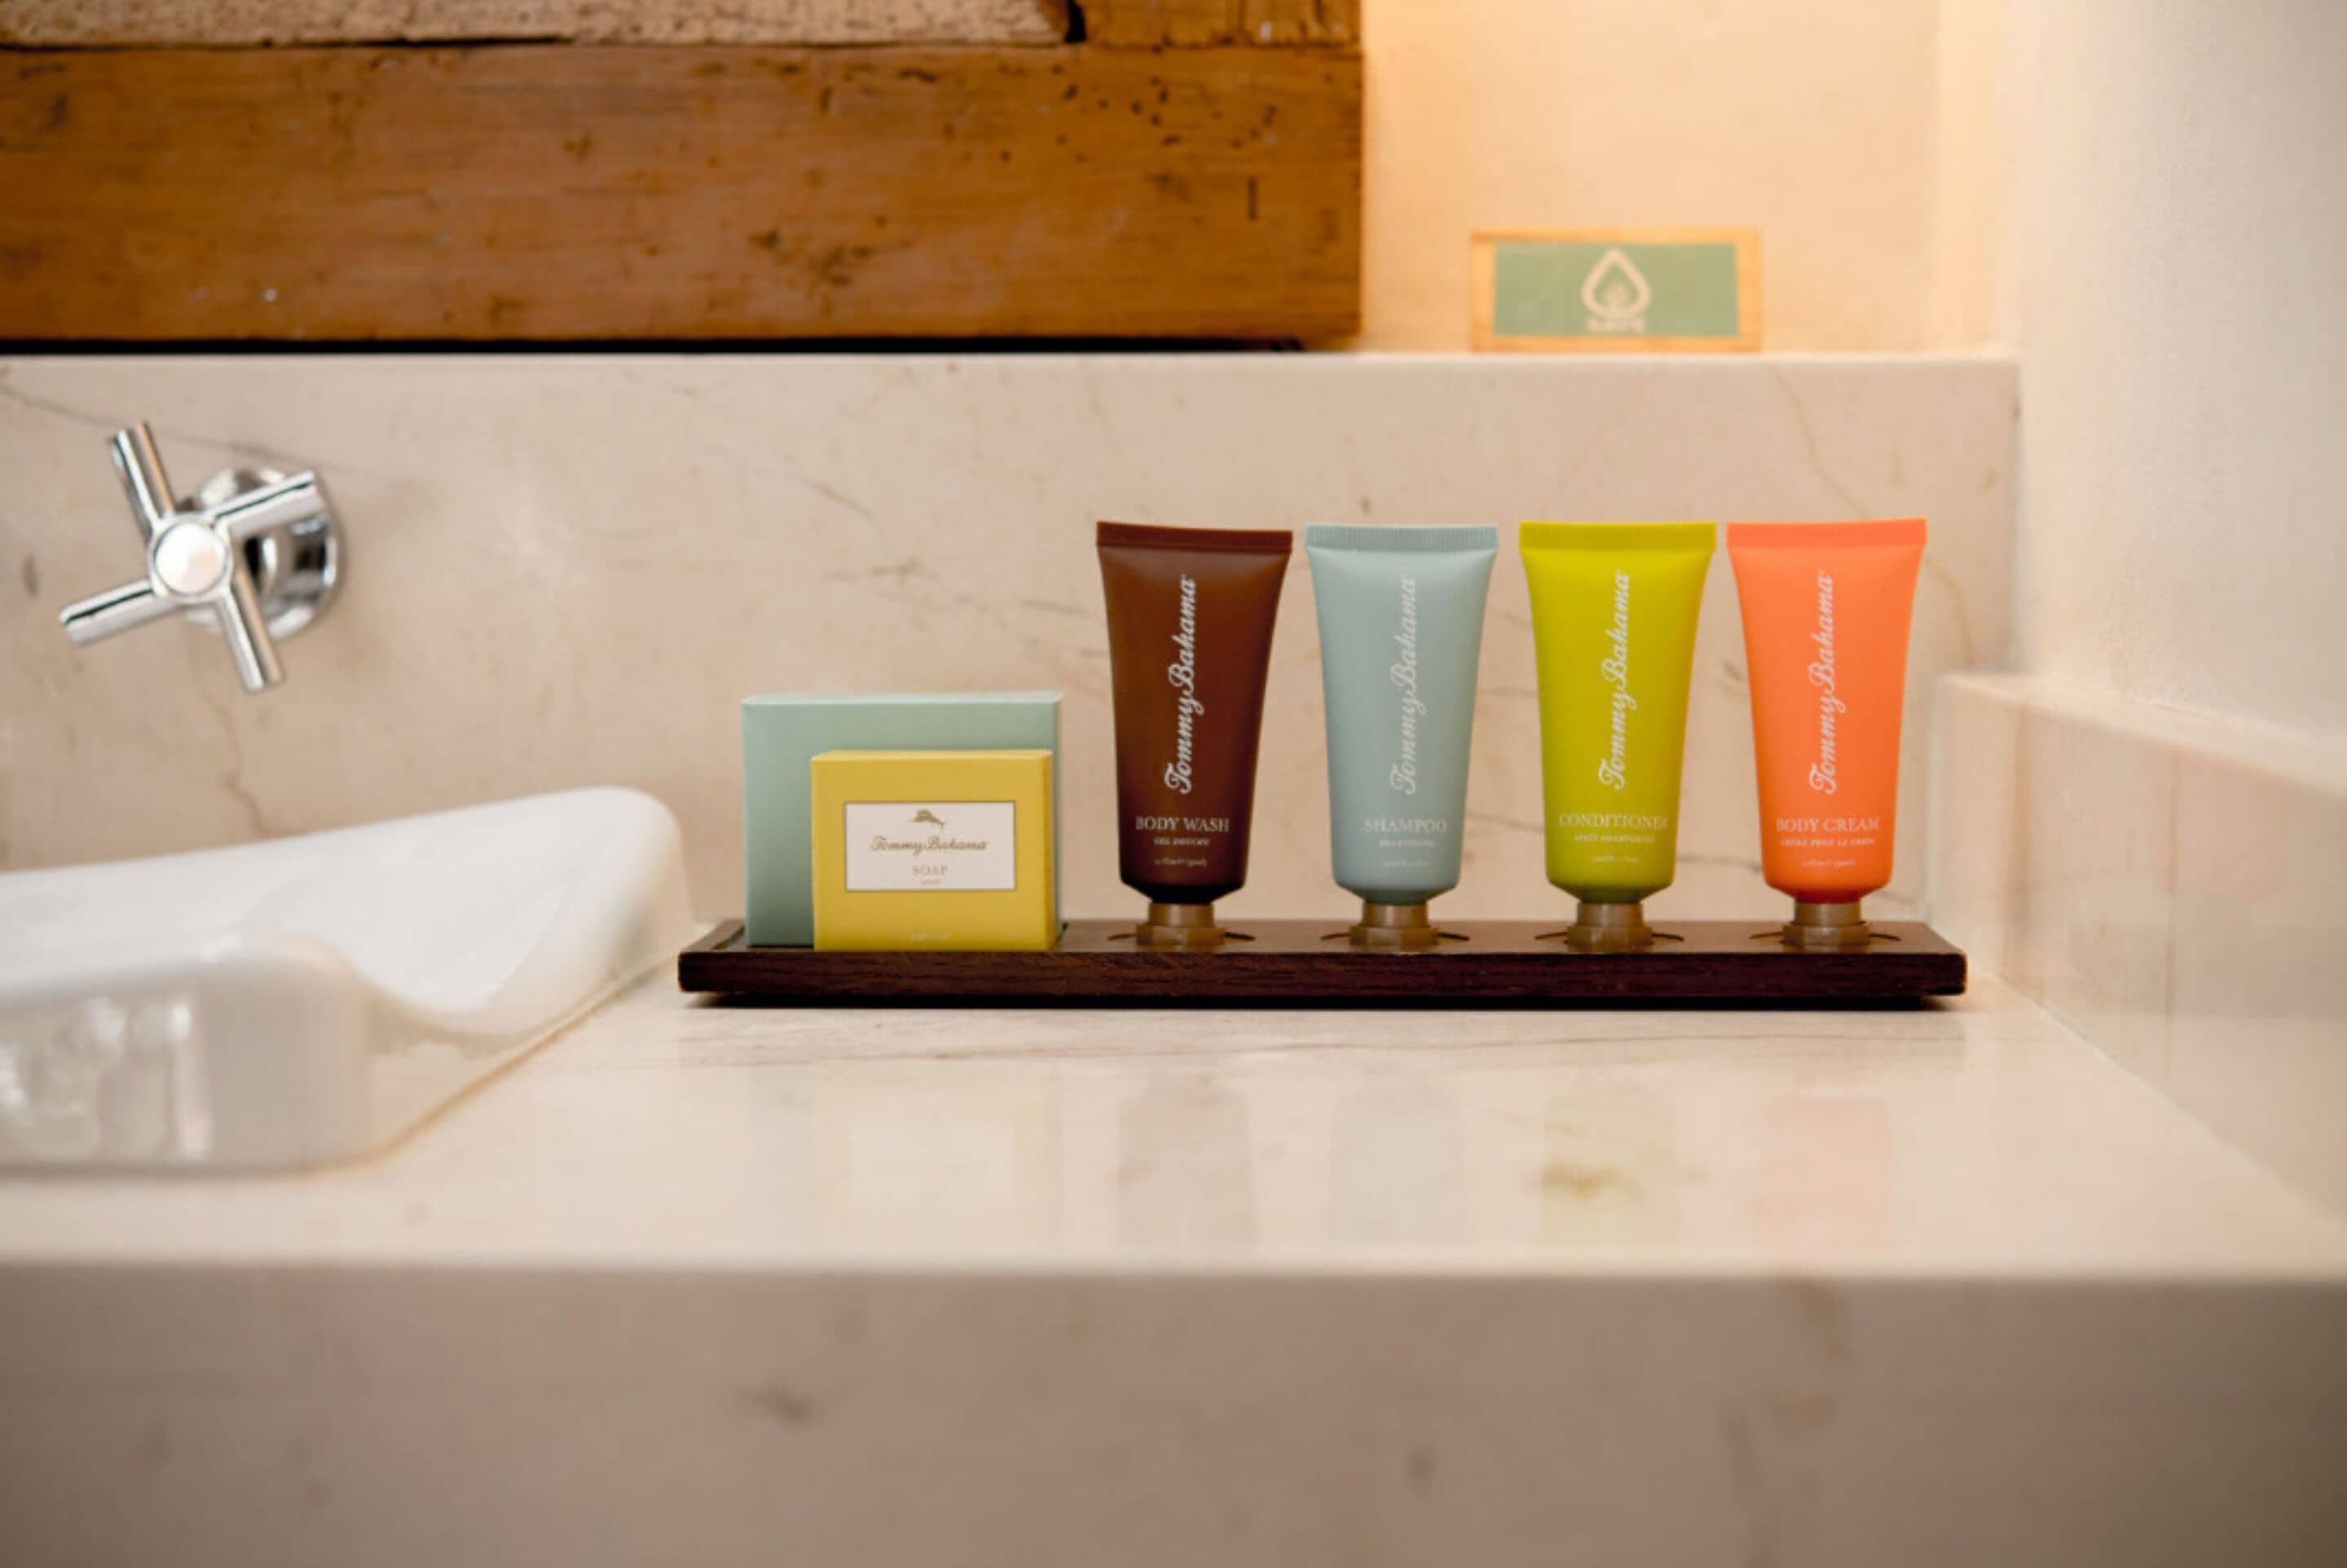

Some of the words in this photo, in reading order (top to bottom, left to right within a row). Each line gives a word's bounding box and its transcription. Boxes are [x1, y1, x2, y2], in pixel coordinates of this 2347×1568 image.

[1168, 575, 1196, 693] Bahama
[1389, 575, 1416, 693] Bahama
[1601, 571, 1631, 691] Bahama
[1808, 572, 1834, 693] Bahama
[1164, 690, 1205, 795] Tommy
[1389, 690, 1427, 795] Tommy
[1598, 689, 1638, 791] Tommy
[1808, 690, 1847, 796] Tommy
[870, 835, 923, 856] Tommy
[925, 835, 988, 851] Bahama
[913, 865, 947, 875] SOAP
[1135, 816, 1180, 830] BODY
[1184, 817, 1230, 833] WASH
[1363, 817, 1448, 834] SHAMPOO
[1777, 817, 1821, 832] BODY
[1823, 817, 1879, 831] CREAM
